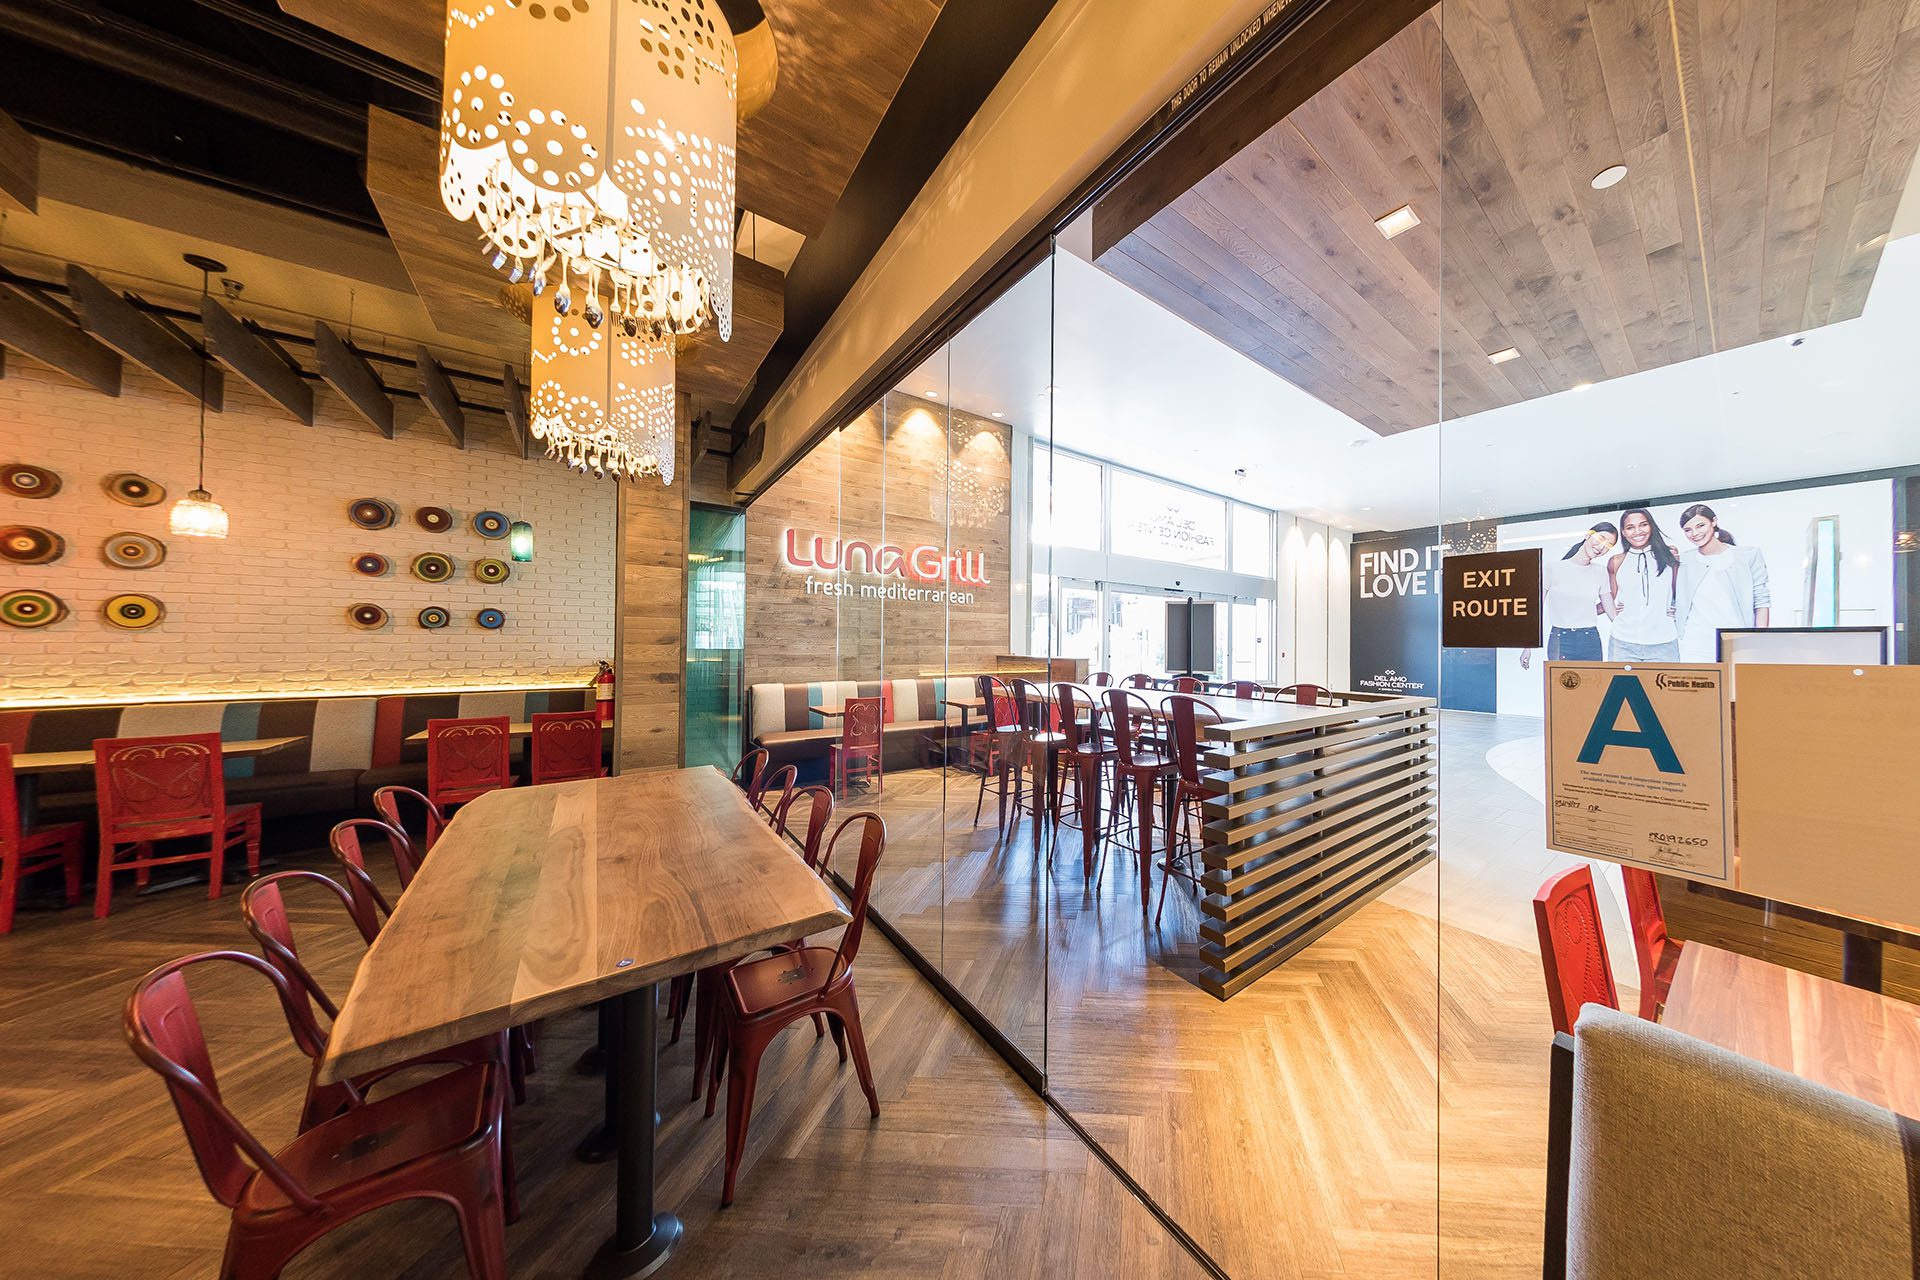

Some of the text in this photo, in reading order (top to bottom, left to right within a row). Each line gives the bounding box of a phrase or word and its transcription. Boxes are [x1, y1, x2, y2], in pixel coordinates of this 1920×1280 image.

[1170, 0, 1293, 111] THIS DOOR TO REMAIN UNLOCKED WHENE
[1360, 549, 1419, 576] FIND
[805, 575, 974, 605] fresh mediterranean
[1360, 568, 1444, 598] LOVE I
[1463, 568, 1516, 588] EXIT
[1452, 598, 1528, 617] ROUTE
[1667, 680, 1690, 688] Public
[1576, 675, 1685, 775] A
